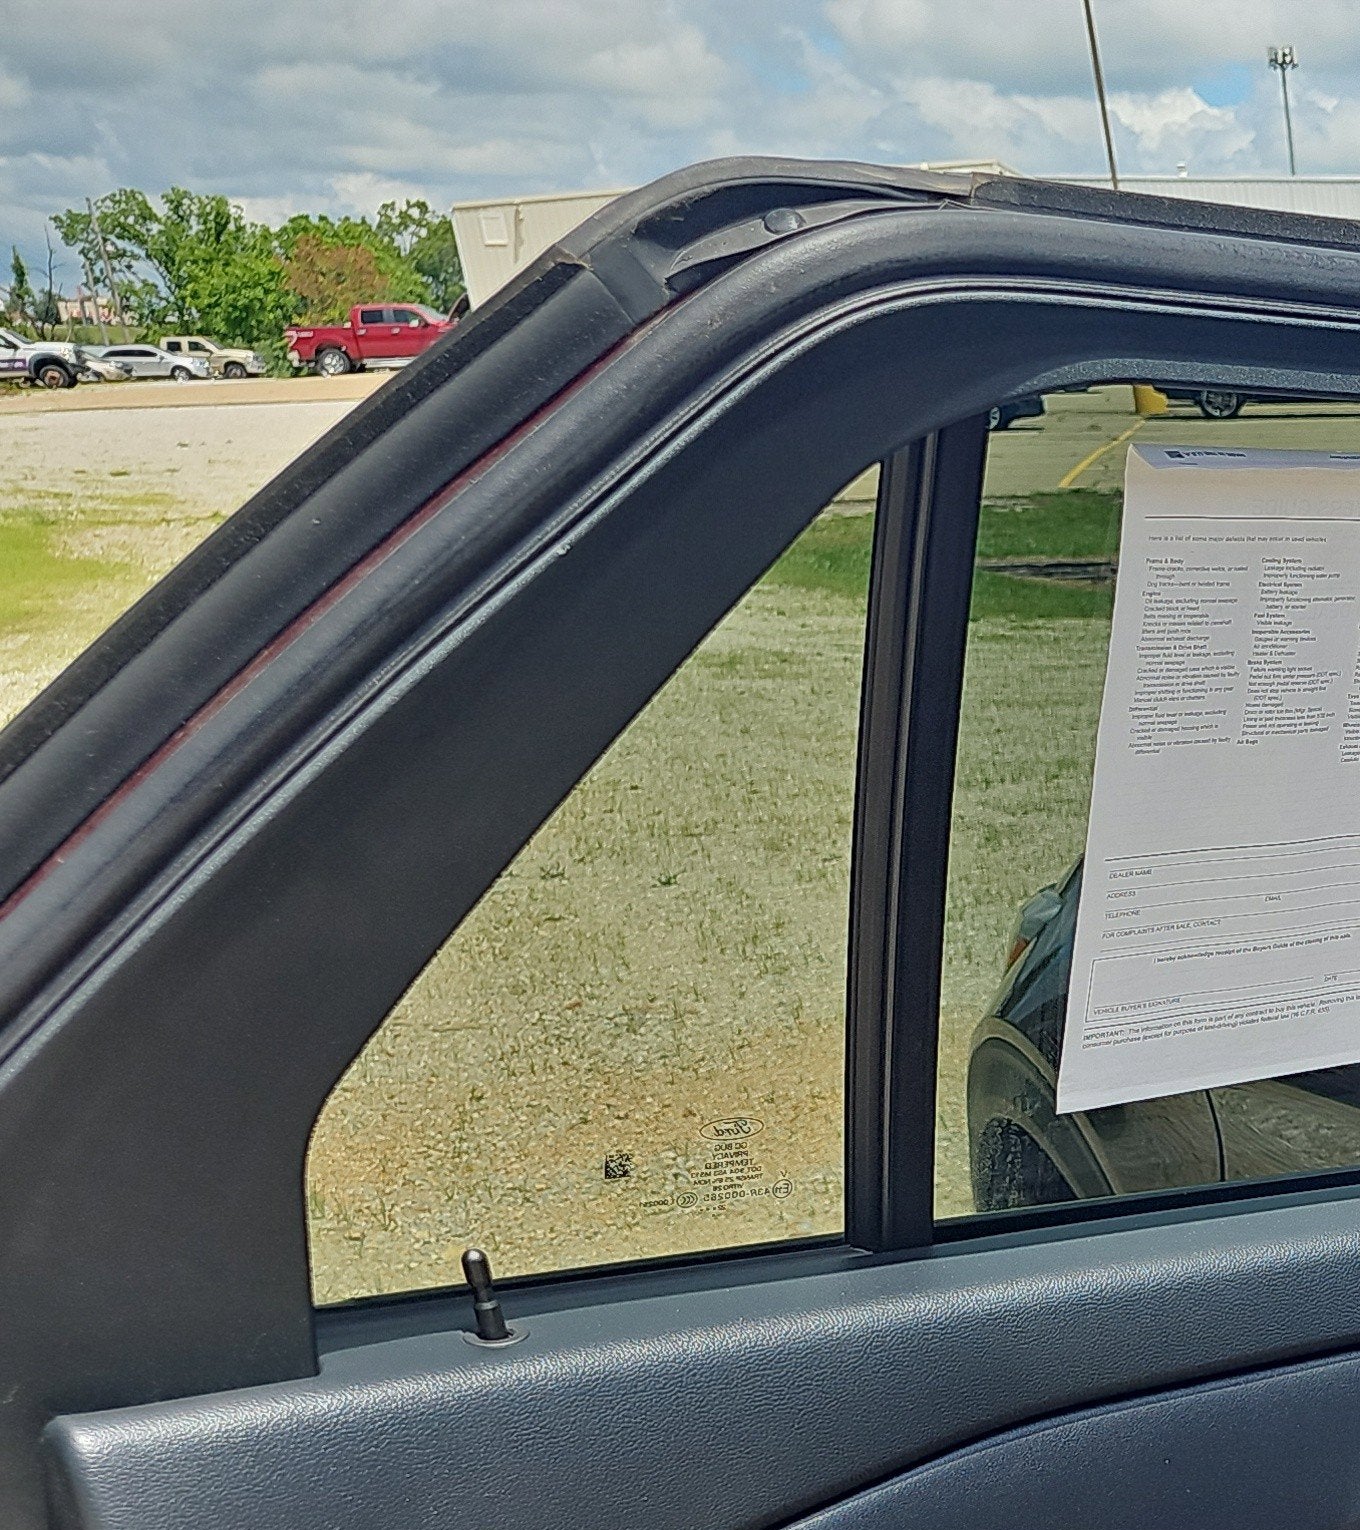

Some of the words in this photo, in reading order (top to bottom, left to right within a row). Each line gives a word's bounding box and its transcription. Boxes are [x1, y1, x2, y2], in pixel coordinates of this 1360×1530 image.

[1109, 869, 1134, 880] DEALER
[1134, 868, 1152, 876] NAME
[1106, 890, 1137, 900] ADDRESS
[1105, 910, 1141, 920] TELEPHONE
[1101, 931, 1115, 940] FOR
[1115, 927, 1155, 938] COMPLAINTS
[1156, 924, 1175, 933] AFTER
[1192, 919, 1222, 928] CONTACT
[1177, 951, 1214, 960] acknowledge
[1093, 1007, 1119, 1016] VEHICLE
